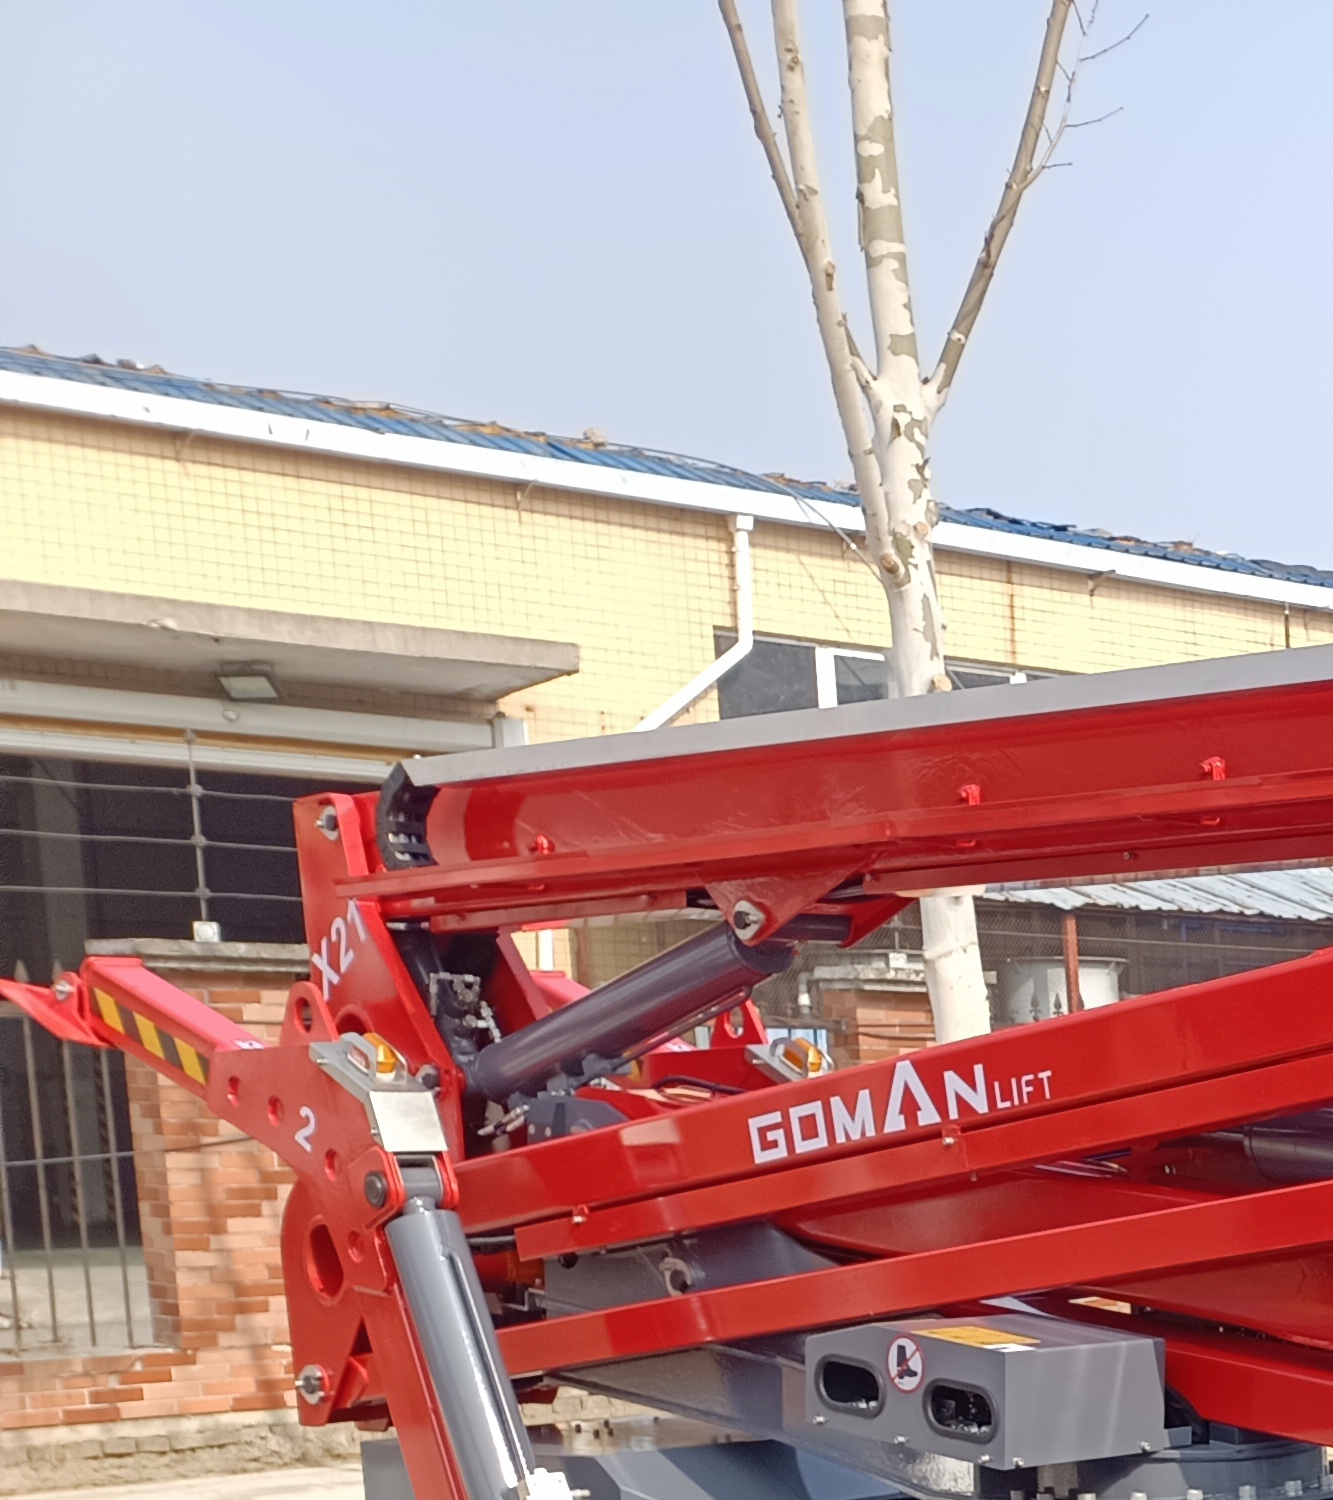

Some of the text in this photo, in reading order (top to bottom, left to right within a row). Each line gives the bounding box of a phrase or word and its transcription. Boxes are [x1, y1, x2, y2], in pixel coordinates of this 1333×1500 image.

[311, 898, 368, 1002] X21
[294, 1105, 317, 1153] 2
[748, 1059, 1053, 1165] GOMAN LIFT
